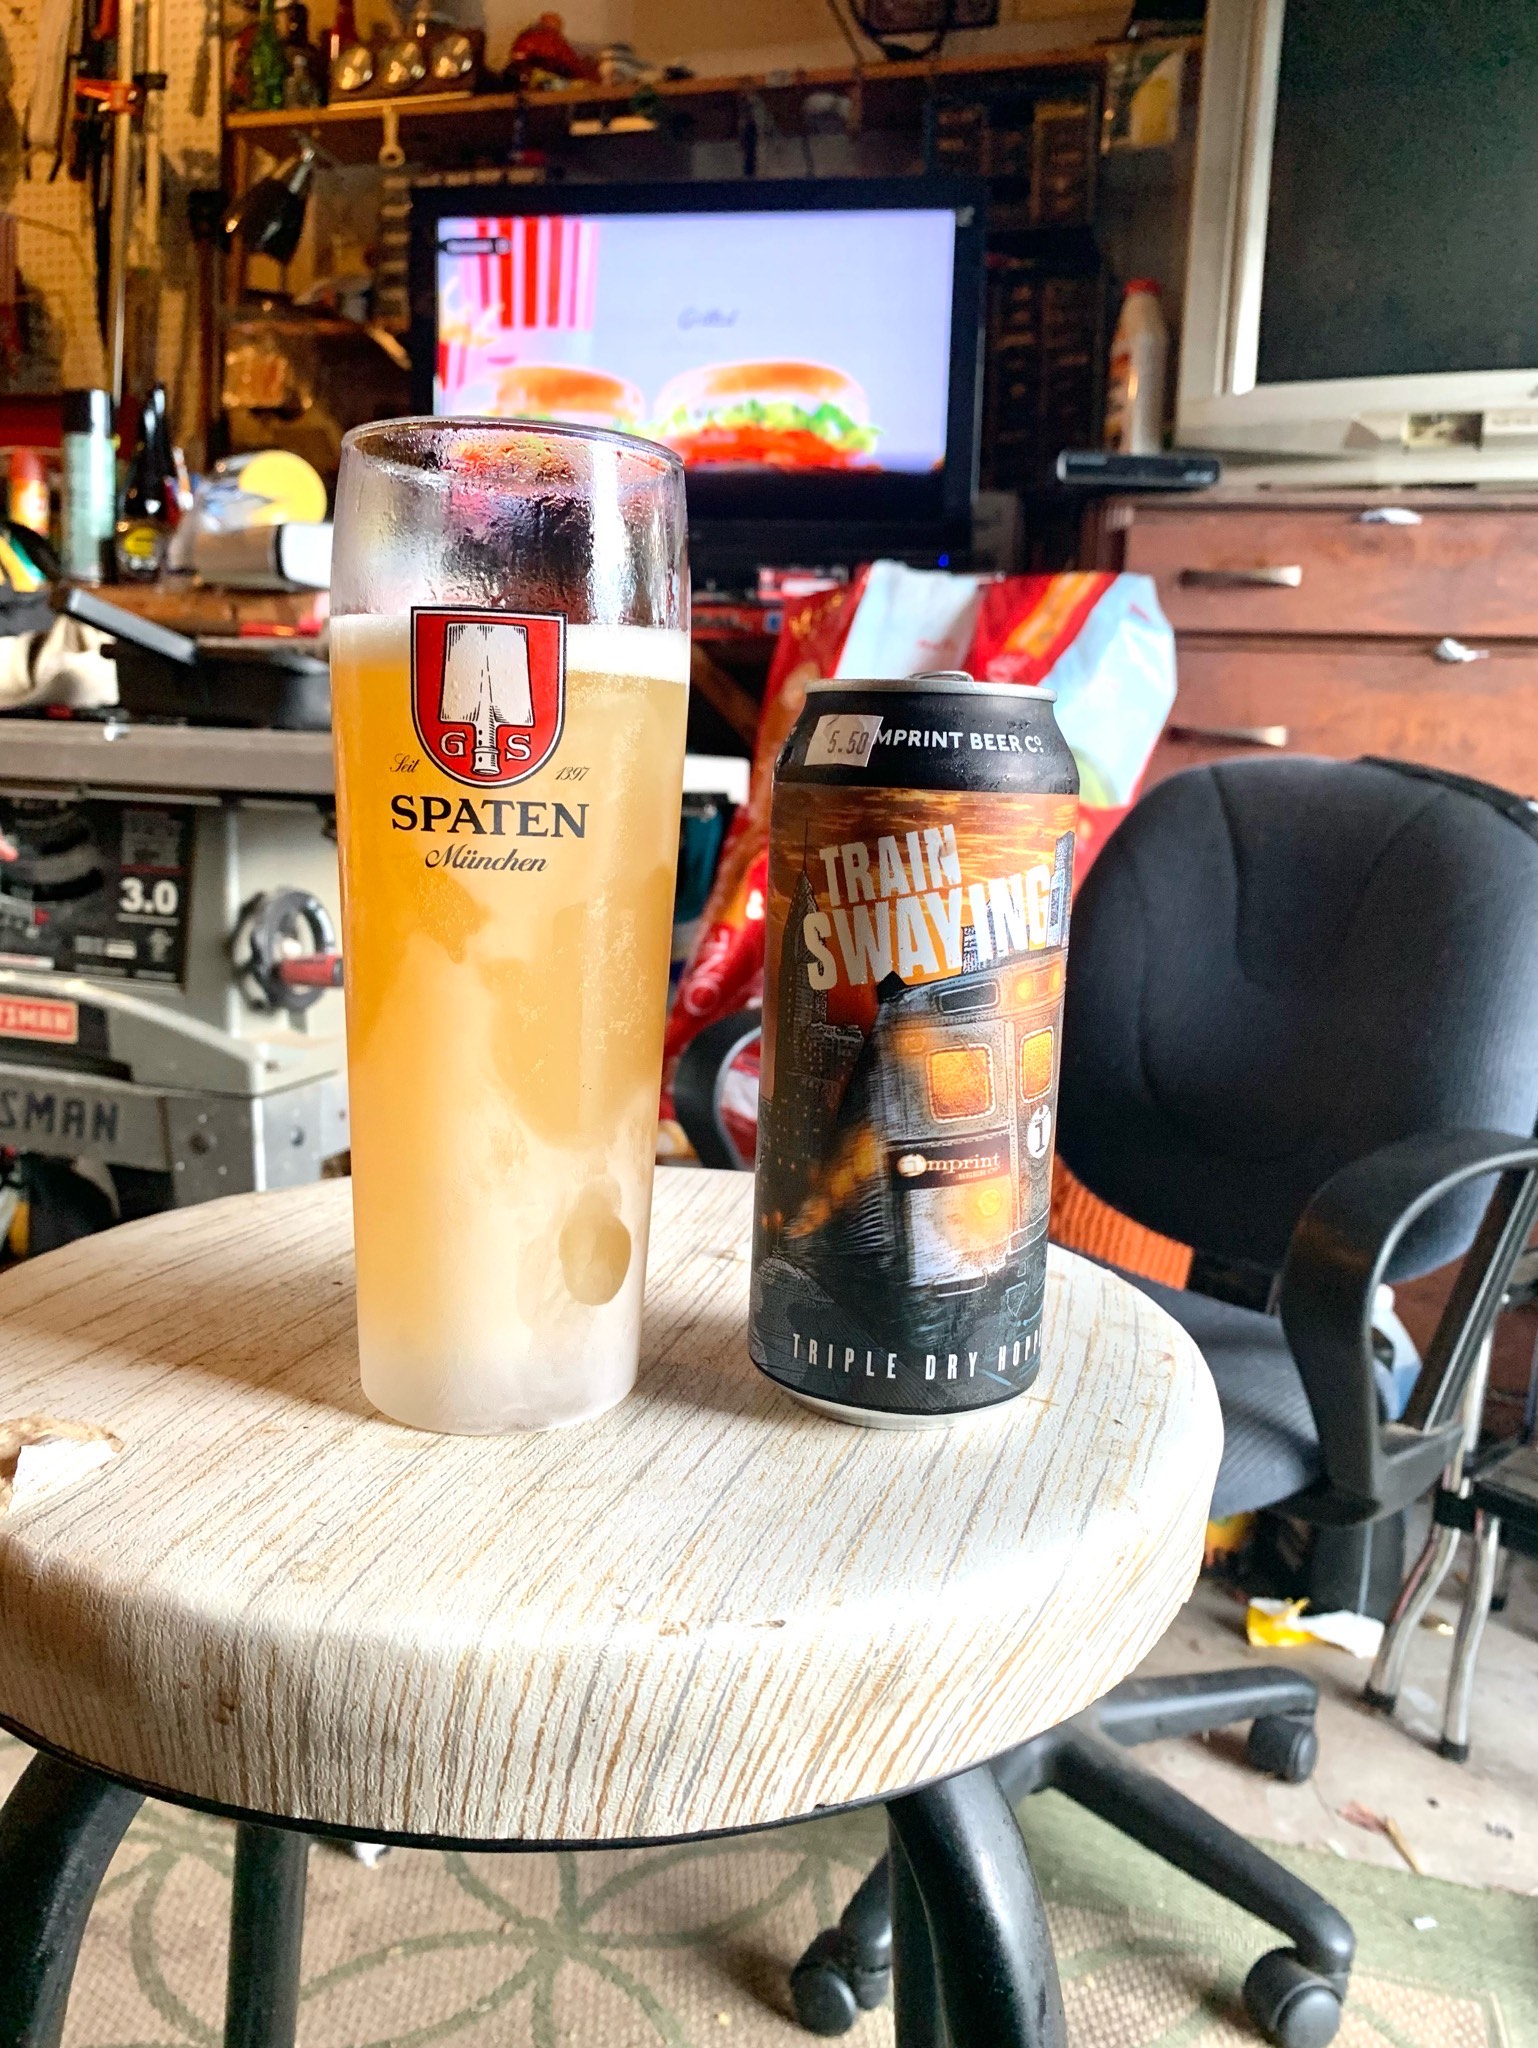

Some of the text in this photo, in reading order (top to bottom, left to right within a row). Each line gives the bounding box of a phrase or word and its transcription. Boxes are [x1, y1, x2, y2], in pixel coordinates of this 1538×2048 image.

[440, 731, 531, 761] G S
[826, 730, 869, 755] 5.50
[873, 729, 964, 749] MPRINT
[970, 733, 1022, 753] BEER
[389, 753, 420, 773] Seit
[554, 766, 590, 782] 1397
[391, 794, 590, 839] SPATEN
[425, 843, 548, 872] München
[819, 823, 962, 907] TRAIN
[119, 876, 180, 915] 3.0
[803, 864, 1052, 991] SWAYING
[792, 1333, 898, 1379] TRIPLE
[925, 1352, 979, 1380] DRY
